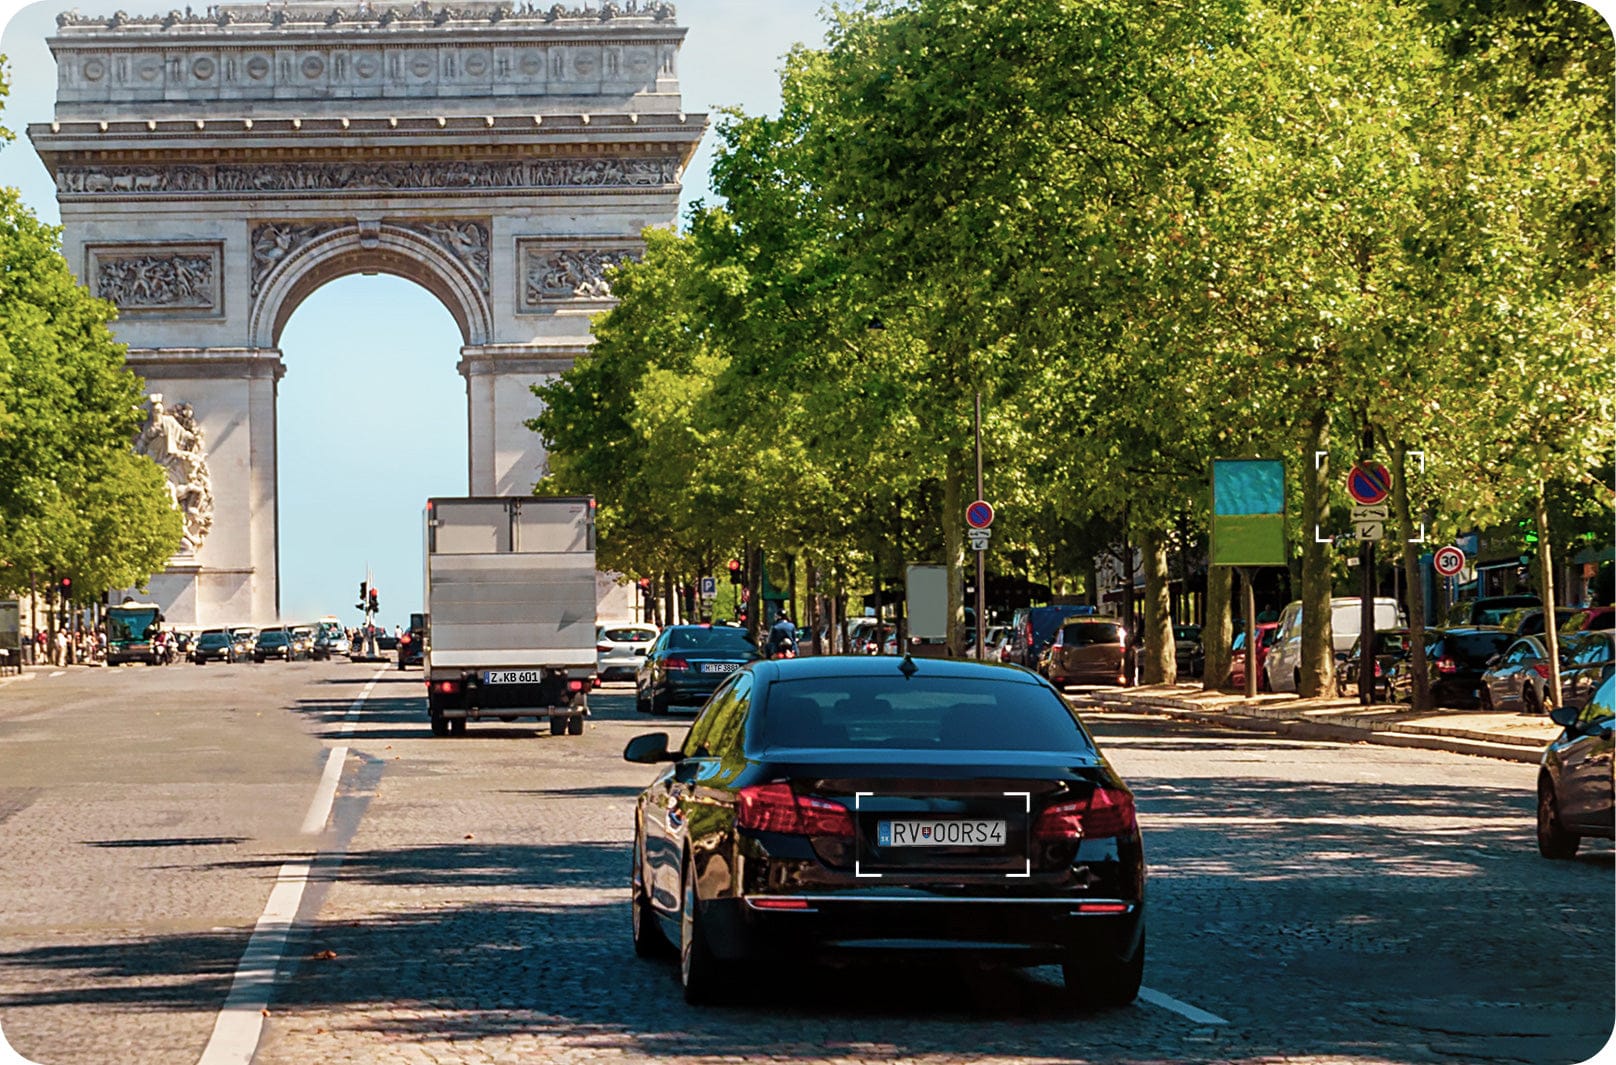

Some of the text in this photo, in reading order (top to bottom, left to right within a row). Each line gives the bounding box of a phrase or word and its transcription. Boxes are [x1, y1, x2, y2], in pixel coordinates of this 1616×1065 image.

[1442, 556, 1458, 567] 30
[705, 580, 713, 591] P
[519, 671, 538, 682] 601
[894, 823, 920, 843] RV
